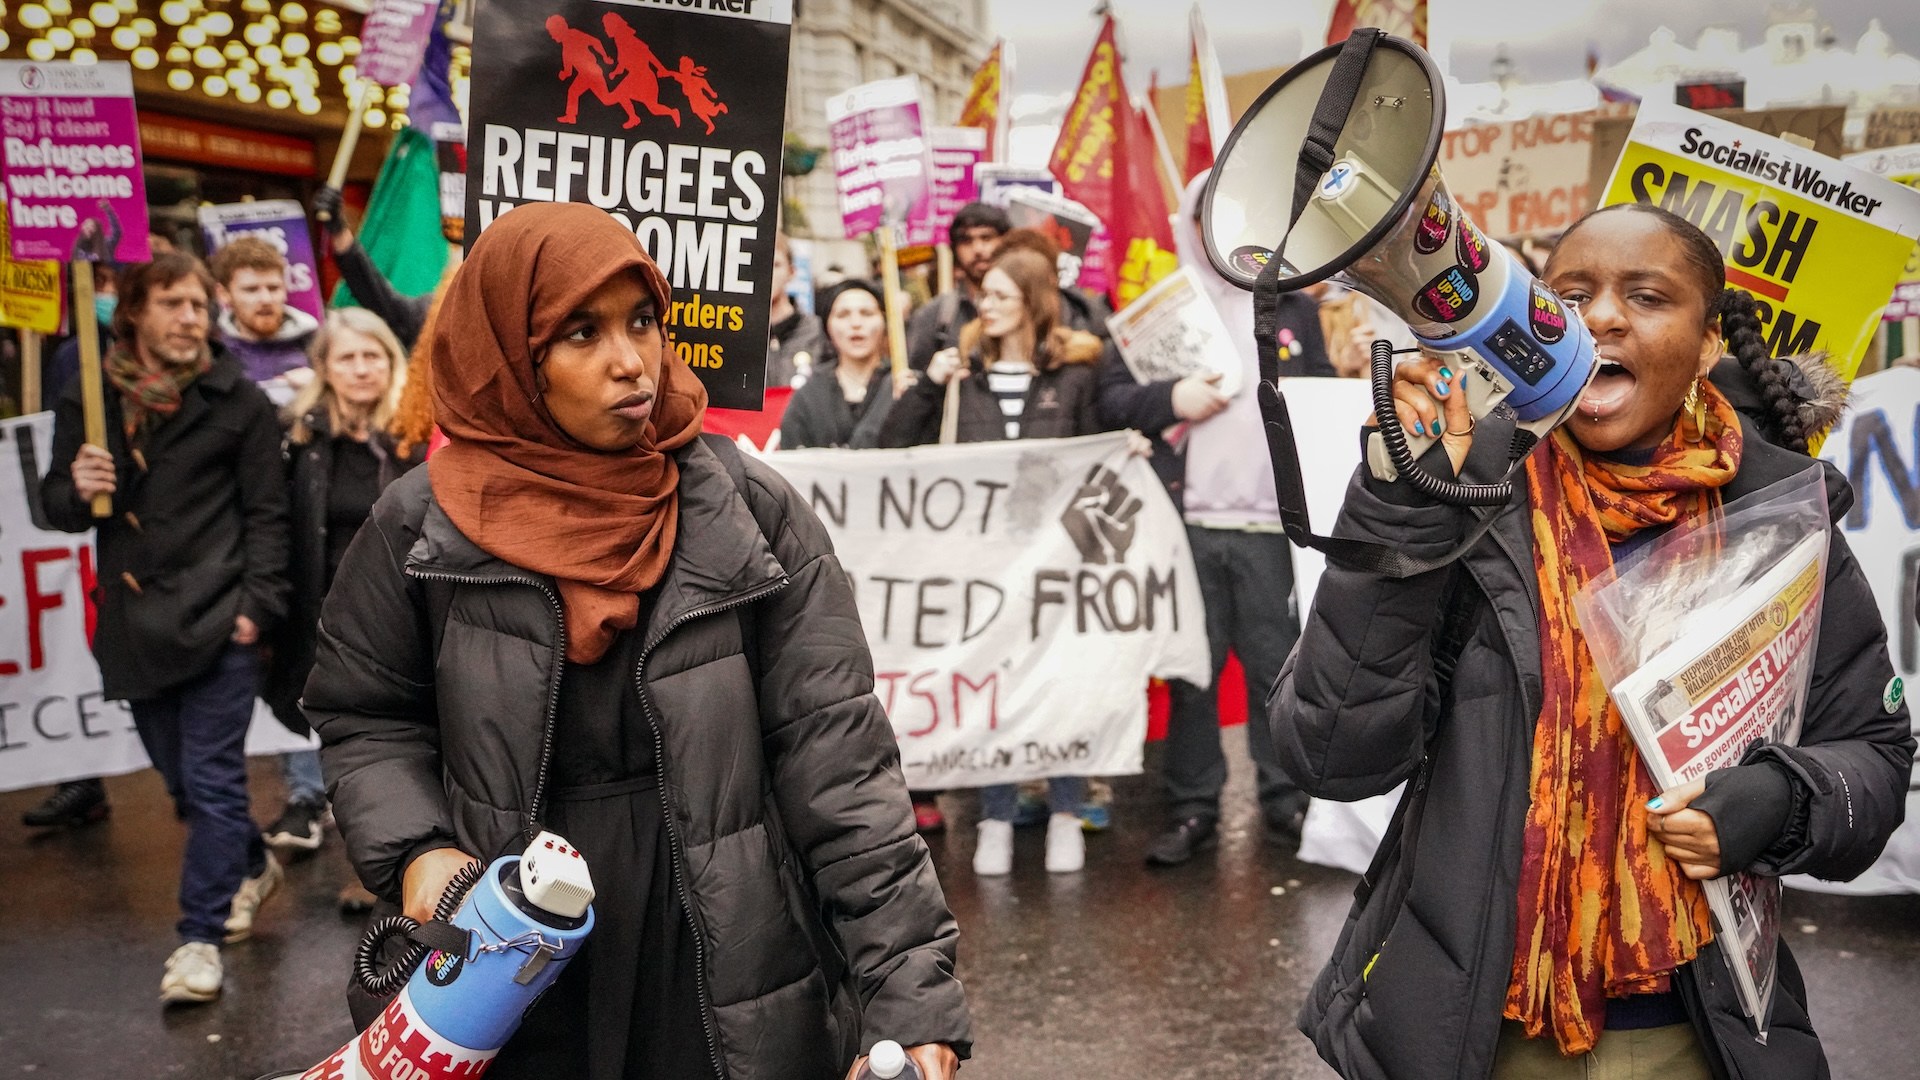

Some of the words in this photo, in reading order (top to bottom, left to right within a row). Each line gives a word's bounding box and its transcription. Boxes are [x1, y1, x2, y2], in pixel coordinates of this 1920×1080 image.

[4, 137, 136, 174] Refugees
[1441, 124, 1501, 160] TOP
[8, 167, 133, 198] welcome
[483, 124, 766, 222] REFUGEES
[1680, 128, 1792, 186] Socialist
[1790, 163, 1882, 217] Worker
[11, 197, 78, 228] here
[1437, 278, 1453, 293] UP
[1447, 292, 1463, 309] TO
[1447, 269, 1474, 302] STAND
[1534, 295, 1546, 309] UP
[1546, 300, 1558, 315] TO
[1534, 308, 1565, 330] RACISM
[810, 480, 847, 528] N
[879, 477, 1009, 534] NOT
[865, 574, 1006, 649] TED
[1031, 565, 1181, 643] FROM
[1680, 654, 1714, 686] STEPPING
[1711, 646, 1724, 663] UP
[1720, 637, 1736, 656] THE
[1731, 624, 1751, 648] FIGHT
[1747, 611, 1768, 635] AFTER
[1685, 665, 1718, 696] WALKOUT
[1715, 640, 1752, 674] WEDNESDAY
[1679, 654, 1775, 749] Socialist
[1681, 760, 1706, 783] The
[1704, 711, 1758, 771] government
[434, 953, 447, 970] TO
[436, 953, 461, 980] TAND
[368, 1014, 390, 1056] ES
